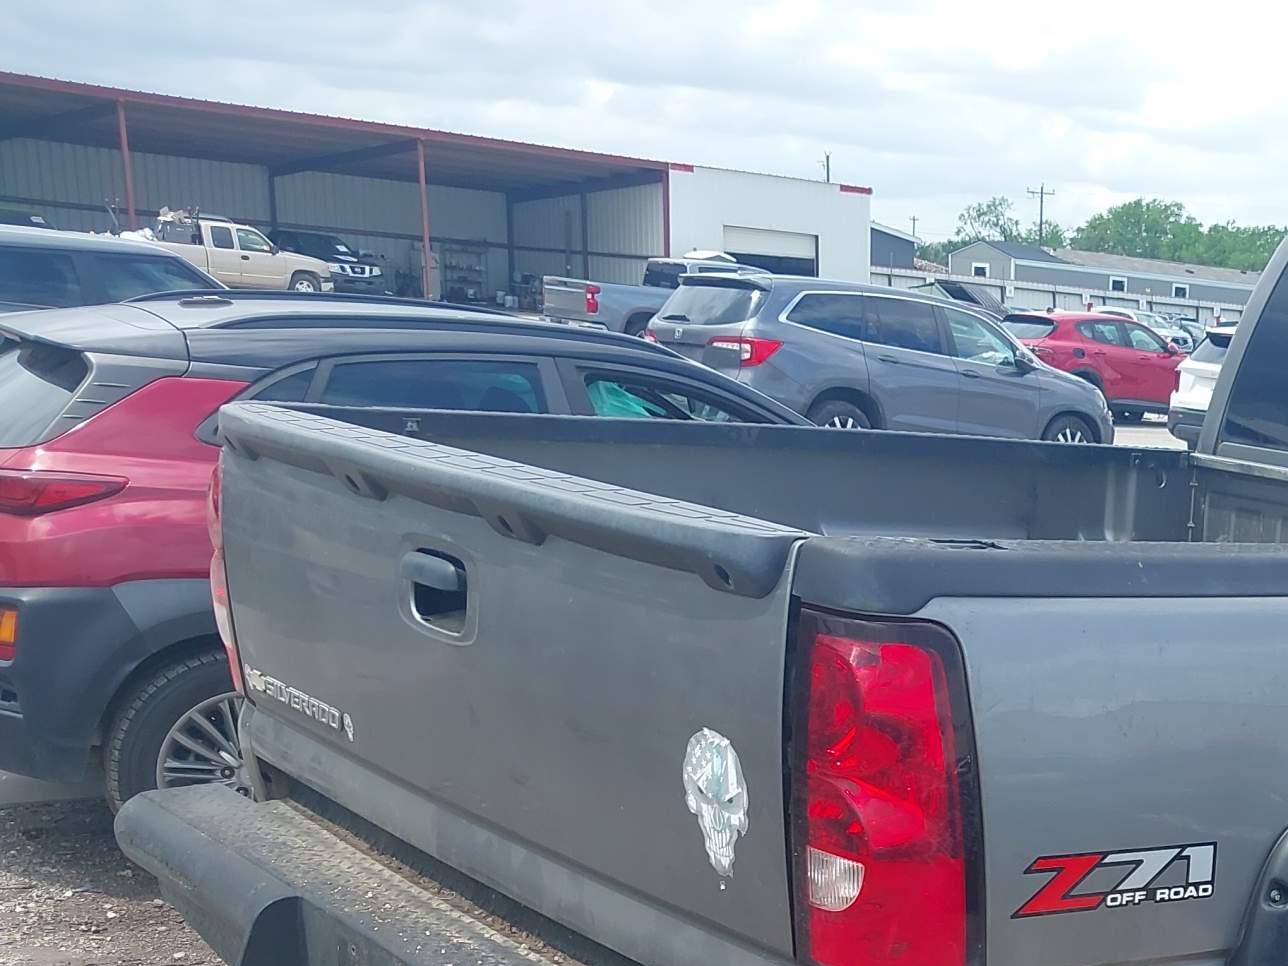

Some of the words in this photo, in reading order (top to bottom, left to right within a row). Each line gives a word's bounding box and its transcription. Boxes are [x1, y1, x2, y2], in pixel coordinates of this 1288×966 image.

[263, 675, 342, 730] SILVERADO
[1011, 842, 1217, 919] Z71
[1105, 890, 1148, 908] OFF
[1155, 883, 1214, 902] ROAD
